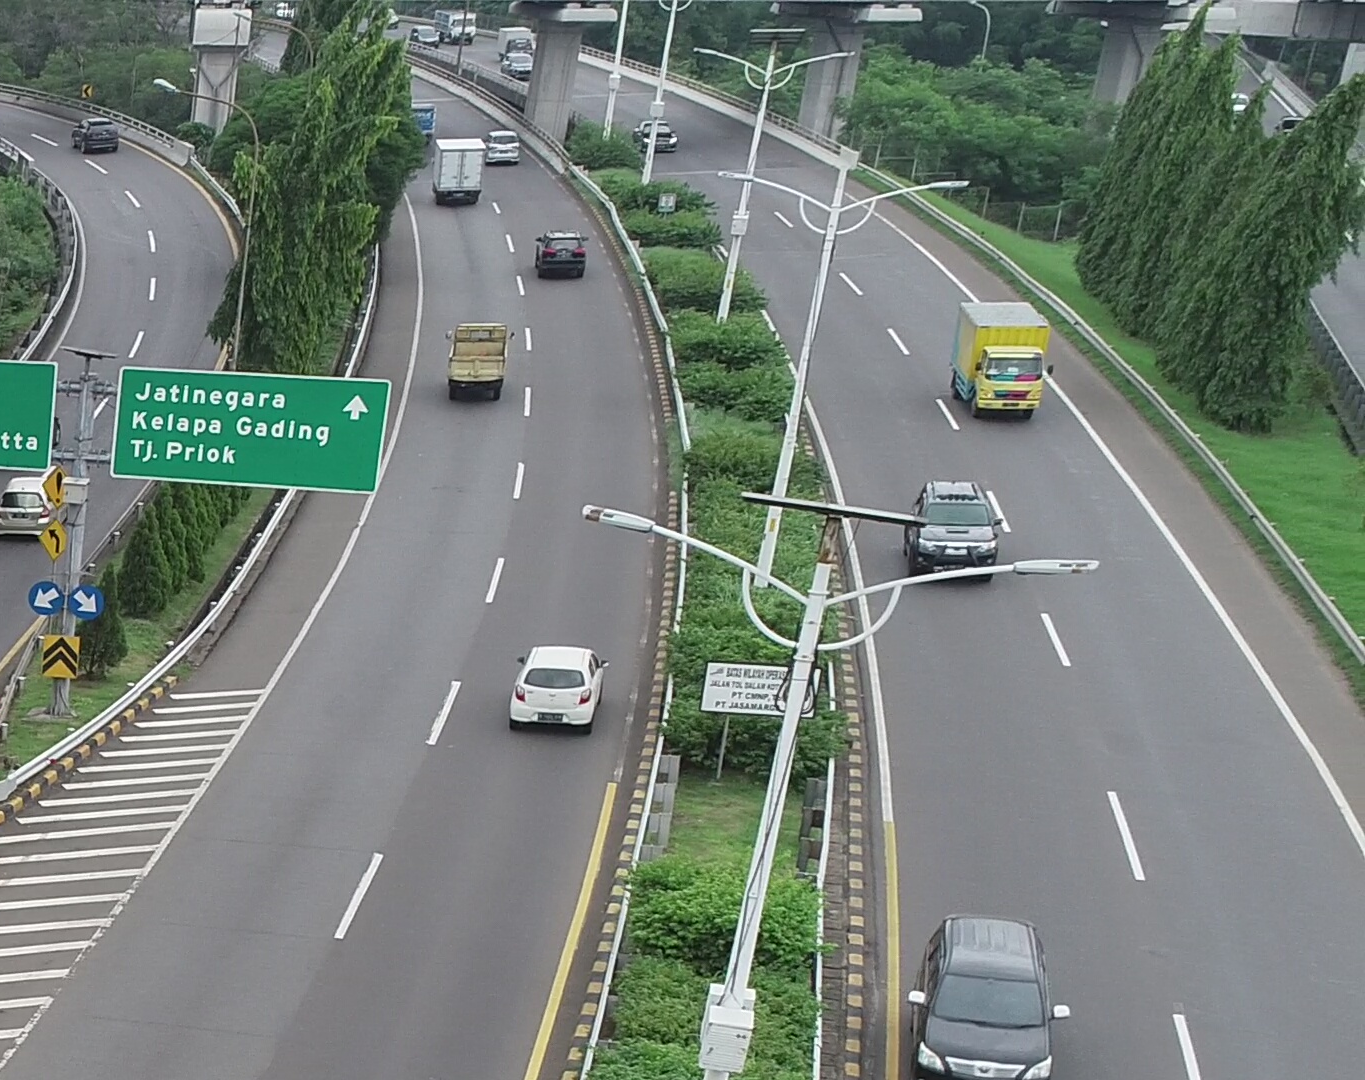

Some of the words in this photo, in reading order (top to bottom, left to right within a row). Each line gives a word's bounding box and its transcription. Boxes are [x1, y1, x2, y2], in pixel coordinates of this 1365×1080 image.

[135, 382, 287, 412] Jatinegara
[132, 411, 223, 436] Kelapa
[236, 416, 331, 447] Gading
[130, 439, 159, 463] Tj.
[166, 441, 237, 464] Priok
[710, 680, 730, 688] JALAN
[731, 681, 743, 689] TOL
[744, 682, 766, 690] DALAM
